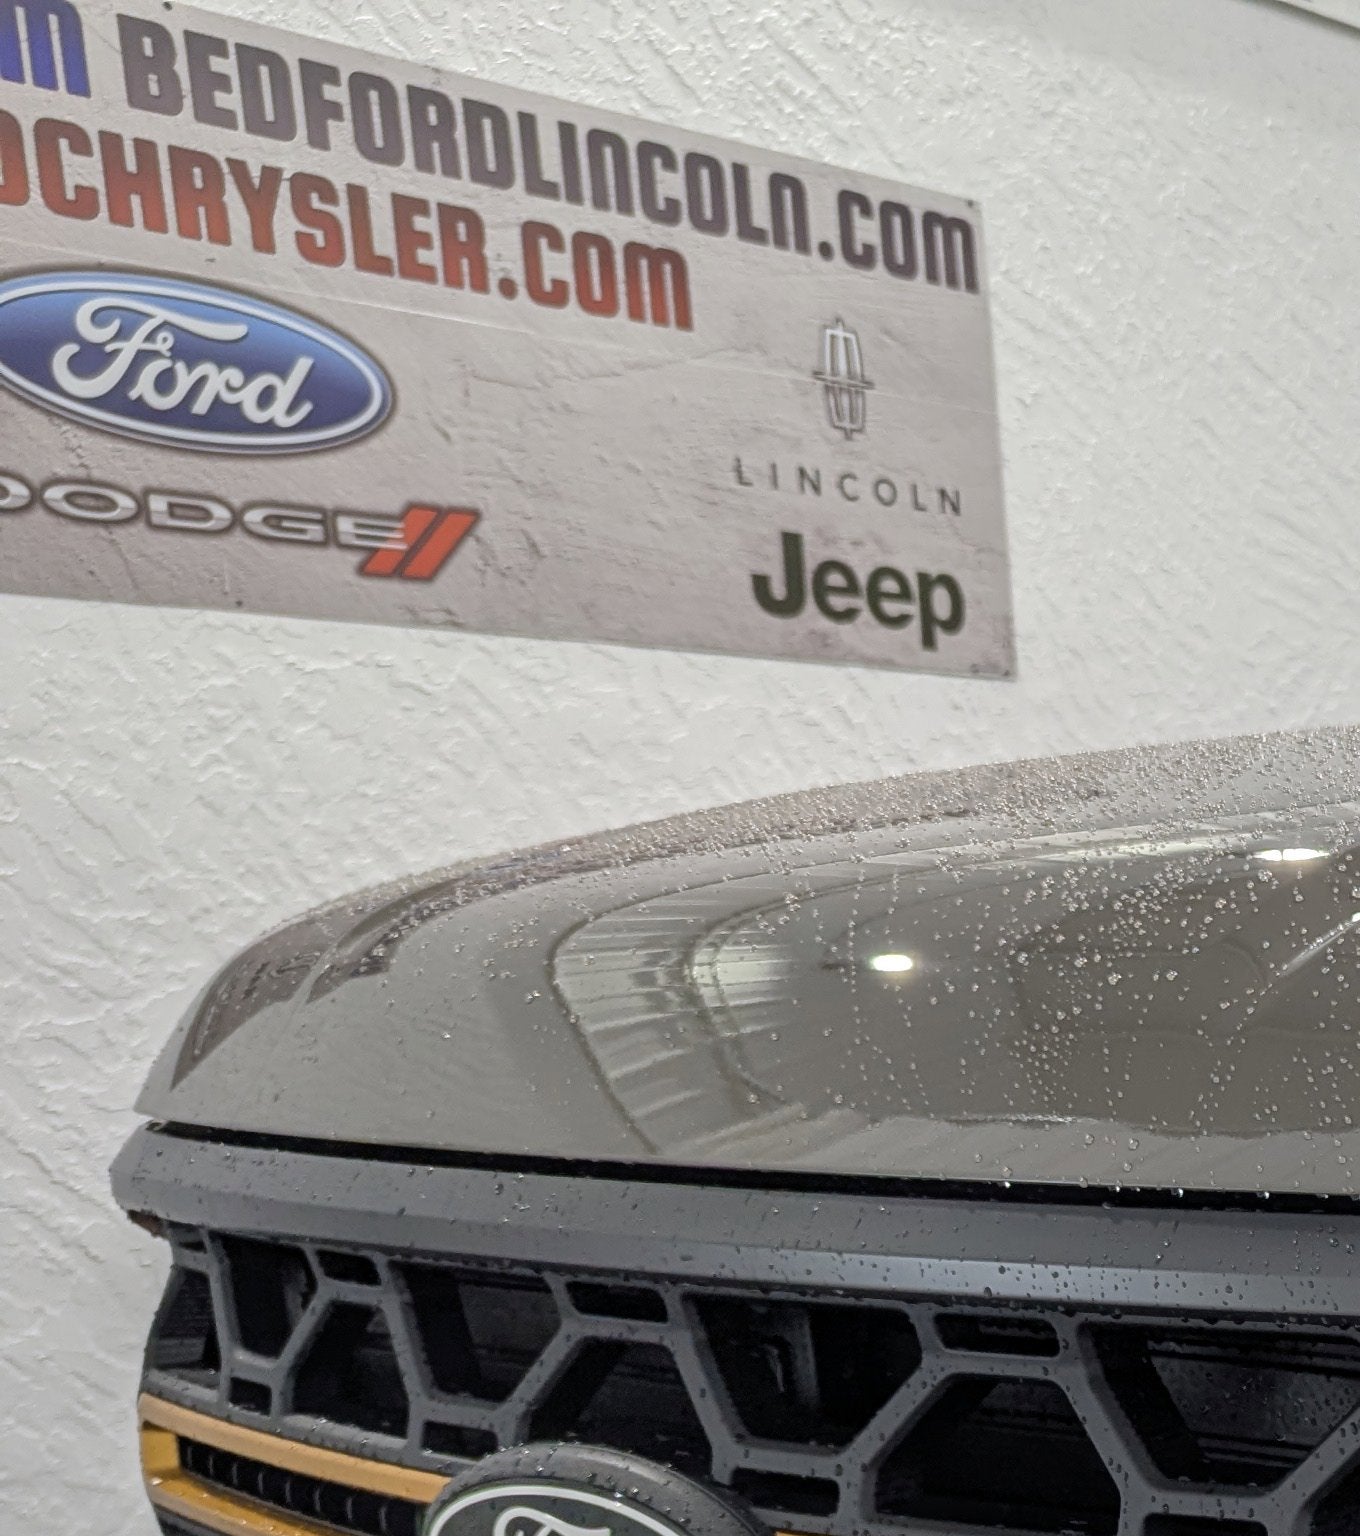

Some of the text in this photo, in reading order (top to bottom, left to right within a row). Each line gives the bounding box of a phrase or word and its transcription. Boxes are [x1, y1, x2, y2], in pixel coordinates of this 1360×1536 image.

[52, 297, 314, 428] Ford
[733, 456, 962, 516] LINCOLN
[750, 530, 967, 652] Jeep
